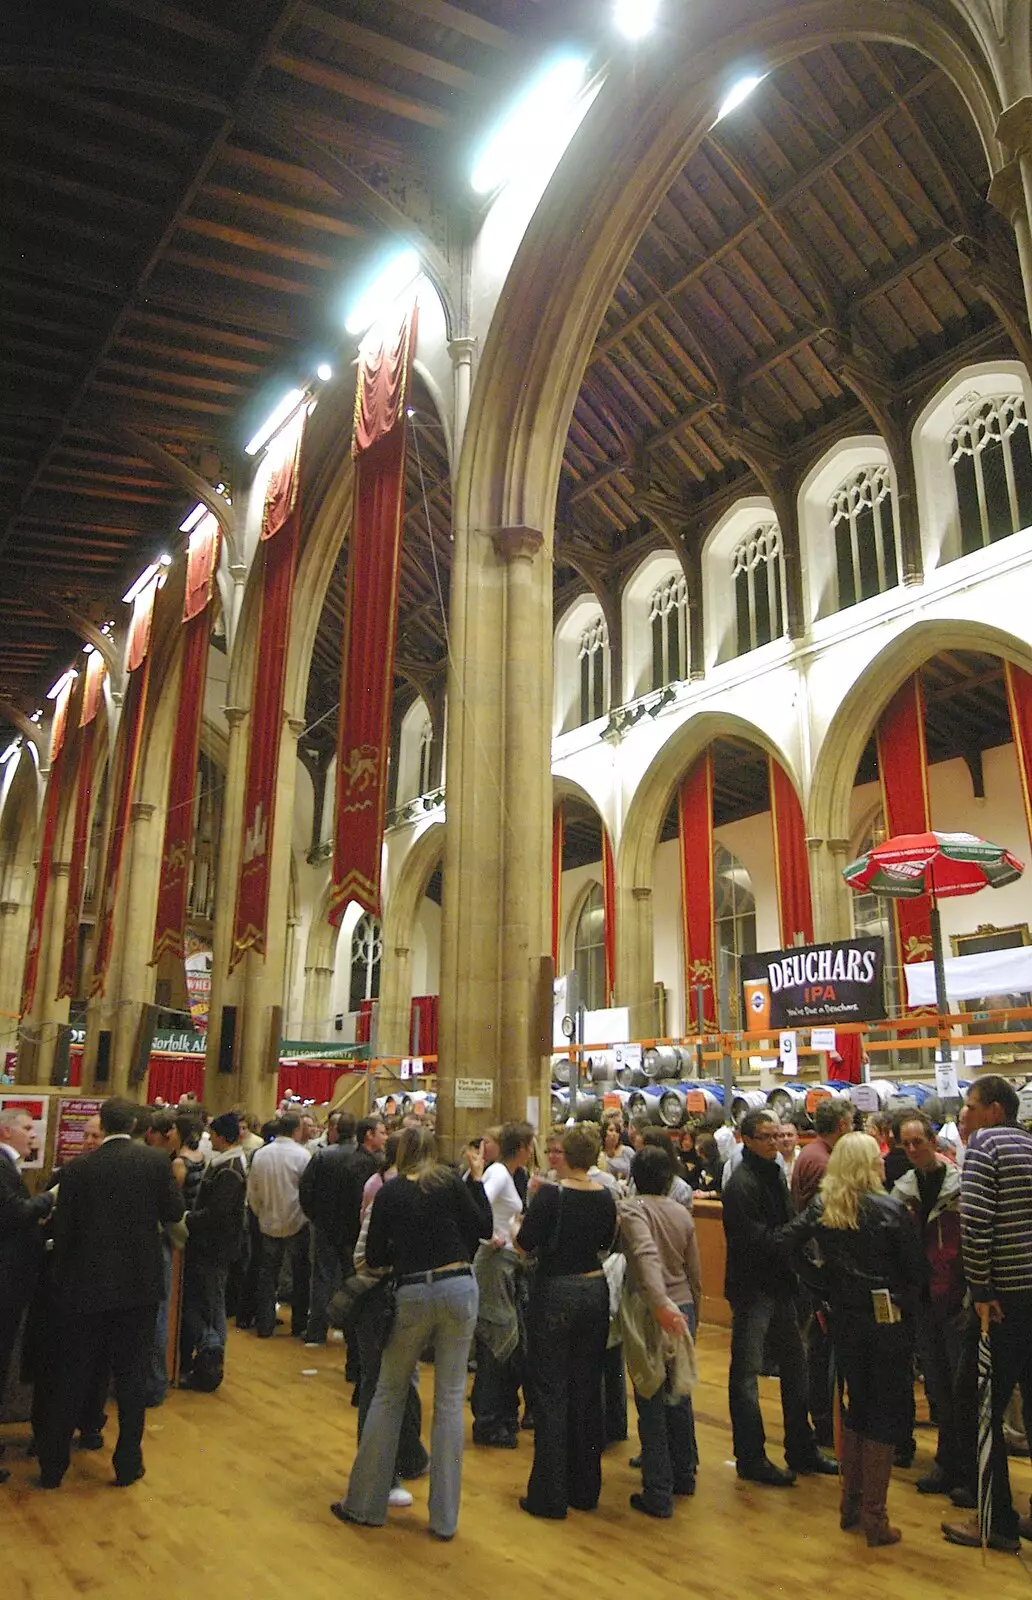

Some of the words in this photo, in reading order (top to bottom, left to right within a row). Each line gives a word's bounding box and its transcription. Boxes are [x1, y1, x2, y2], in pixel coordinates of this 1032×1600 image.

[768, 949, 876, 992] DEUCHARS
[803, 985, 836, 1003] IPA
[783, 1039, 792, 1053] 9
[616, 1049, 622, 1062] 8
